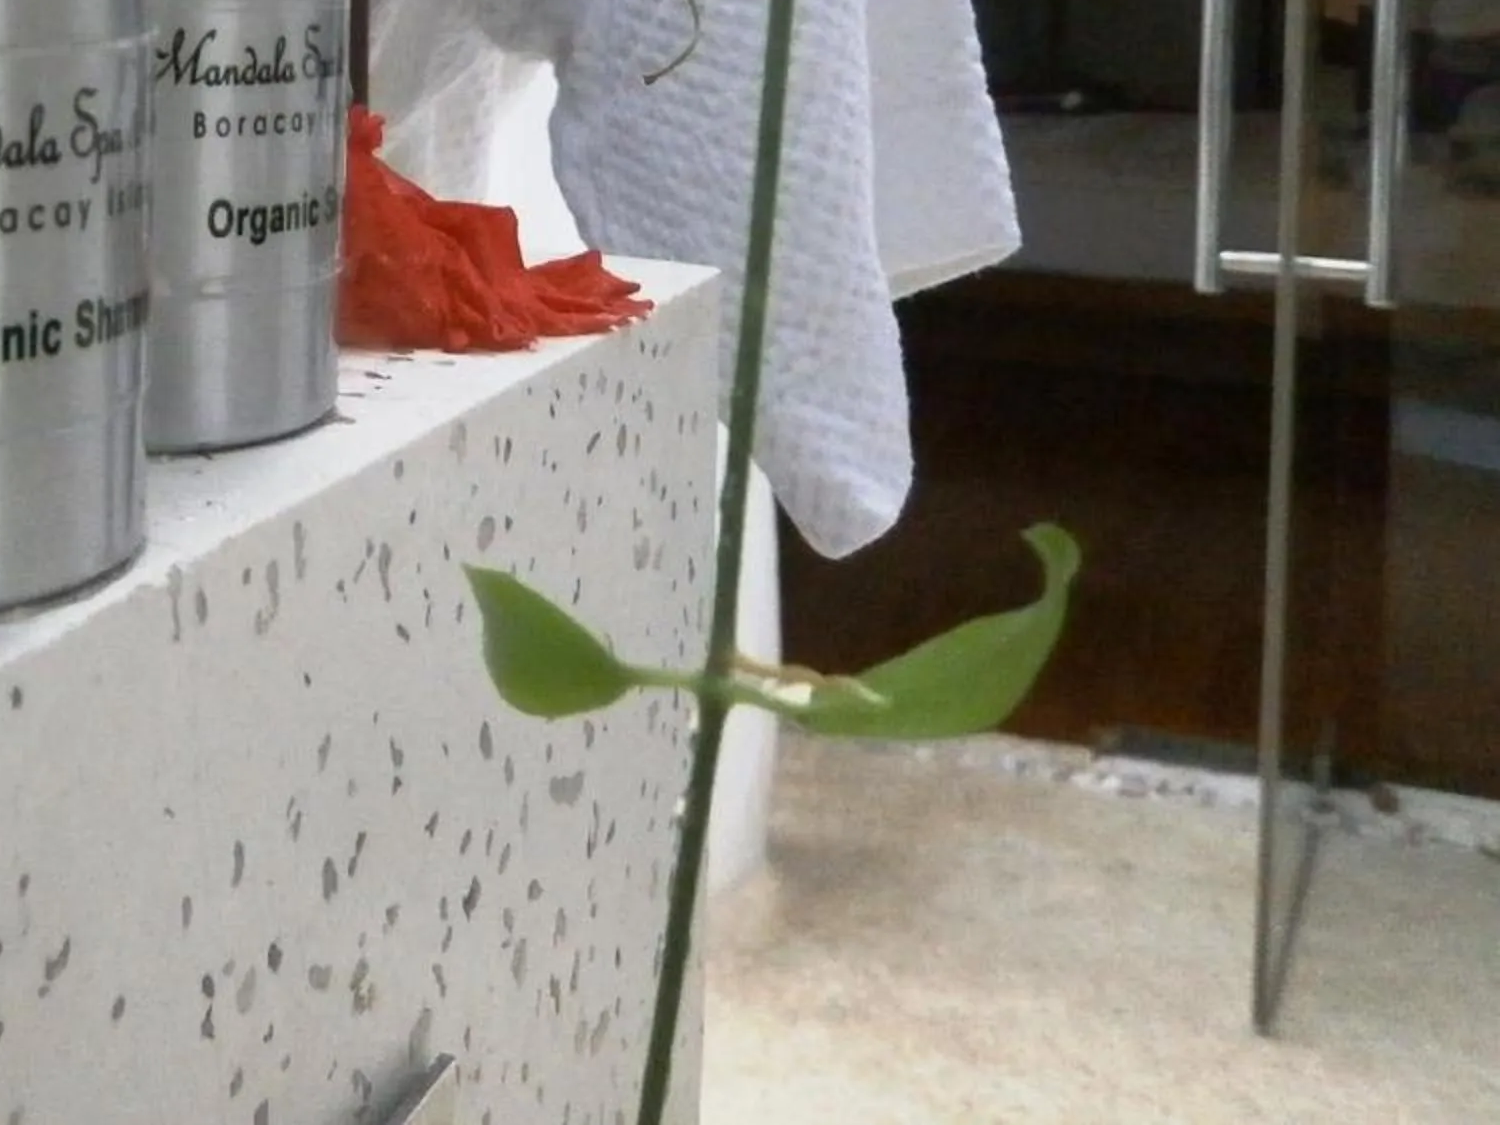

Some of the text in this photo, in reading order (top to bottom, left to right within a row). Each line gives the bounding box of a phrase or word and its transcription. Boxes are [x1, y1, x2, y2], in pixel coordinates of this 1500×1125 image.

[155, 28, 298, 87] Mandala
[193, 111, 317, 139] Boracay
[208, 189, 320, 246] Organic
